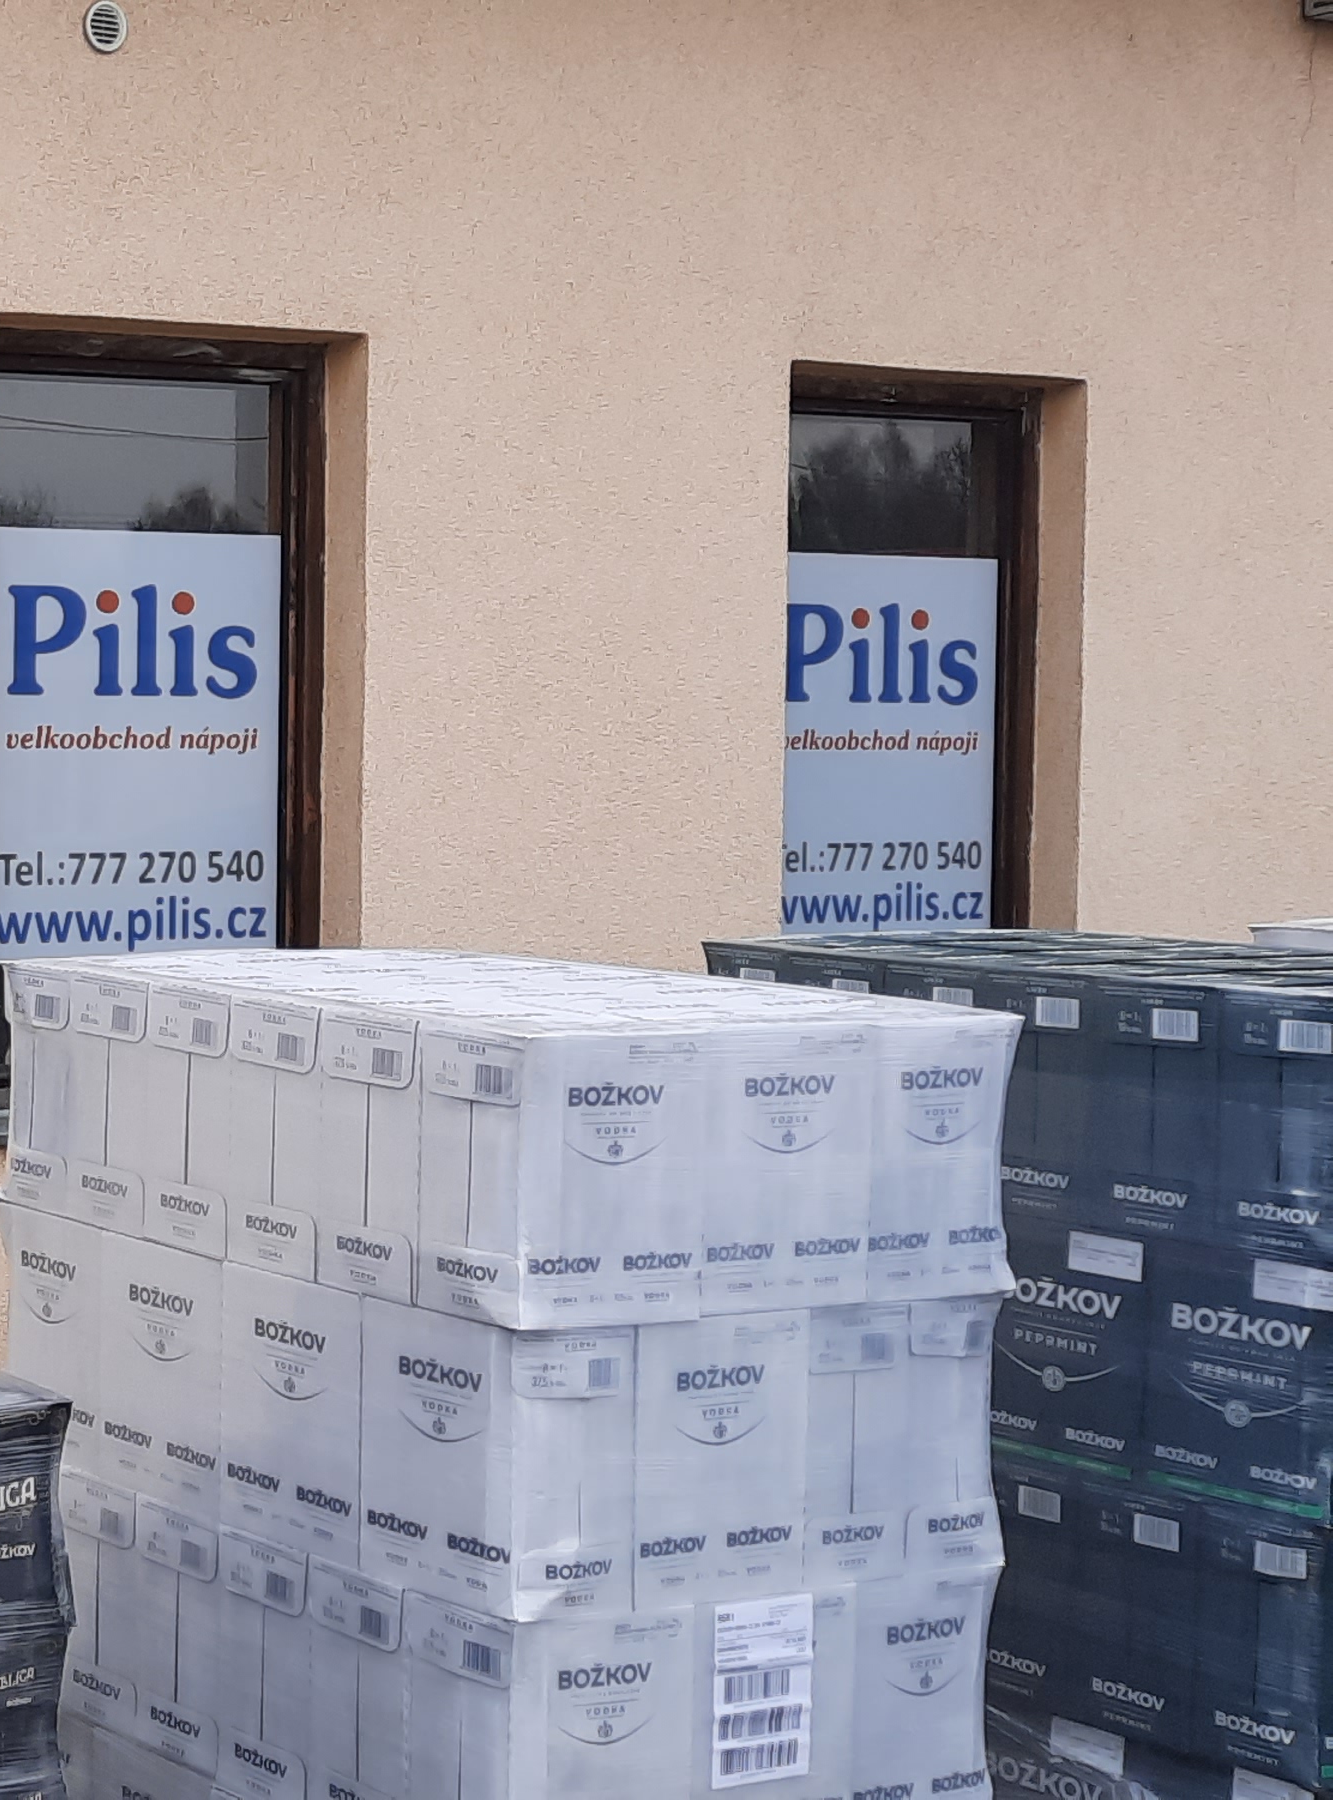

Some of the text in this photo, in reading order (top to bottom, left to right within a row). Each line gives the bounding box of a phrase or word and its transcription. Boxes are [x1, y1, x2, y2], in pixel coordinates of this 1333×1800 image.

[7, 583, 257, 699] Pilis
[786, 603, 978, 706] Pilis
[6, 725, 258, 755] velkoobchod nápoji
[916, 730, 979, 755] nápoji
[138, 851, 197, 884] 270
[207, 850, 264, 883] 540
[882, 841, 928, 870] 270
[937, 840, 982, 870] 540
[745, 1073, 835, 1097] BOŽKOV
[900, 1066, 983, 1090] BOŽKOV
[569, 1082, 664, 1107] BOŽKOV
[596, 1126, 636, 1135] VODKA
[82, 1175, 128, 1197] BOŽKOV
[1000, 1166, 1070, 1189] BOŽKOV
[161, 1193, 210, 1216] BOŽKOV
[1113, 1183, 1188, 1209] BOŽKOV
[246, 1215, 298, 1239] BOŽKOV
[1237, 1201, 1320, 1226] BOŽKOV
[336, 1235, 393, 1261] BOŽKOV
[707, 1242, 774, 1263] BOŽKOV
[795, 1237, 860, 1257] BOŽKOV
[868, 1232, 930, 1251] BOŽKOV
[21, 1251, 76, 1281] BOŽKOV
[437, 1257, 498, 1283] BOŽKOV
[528, 1255, 600, 1275] BOŽKOV
[623, 1251, 692, 1271] BOŽKOV
[129, 1284, 193, 1316] BOŽKOV
[1004, 1276, 1122, 1320] OŽKOV
[255, 1318, 326, 1353] BOŽKOV
[1171, 1302, 1312, 1350] BOŽKOV
[399, 1356, 482, 1392] BOŽKOV
[677, 1365, 765, 1392] BOŽKOV
[990, 1410, 1125, 1452] OŽKOV BOŽKOV
[105, 1421, 152, 1448] BOŽKOV
[167, 1442, 216, 1470] BOŽKOV
[1154, 1445, 1317, 1490] BOŽKOV BOŽKOV
[228, 1463, 352, 1517] BOŽKOV BOŽKOV
[367, 1509, 427, 1540] BOŽKOV
[823, 1525, 884, 1545] BOŽKOV
[928, 1512, 985, 1534] BOŽKOV
[640, 1525, 792, 1558] BOŽKOV BOŽKOV
[546, 1559, 612, 1580] BOŽKOV
[887, 1616, 966, 1645] BOŽKOV
[558, 1662, 652, 1692] BOŽKOV
[986, 1650, 1046, 1677] OŽKOV
[72, 1668, 121, 1701] BOŽKOV
[1092, 1676, 1165, 1711] BOŽKOV
[150, 1705, 201, 1738] BOŽKOV
[586, 1706, 626, 1716] VODKA
[1215, 1710, 1295, 1745] BOŽKOV
[234, 1743, 288, 1779] BOŽKOV
